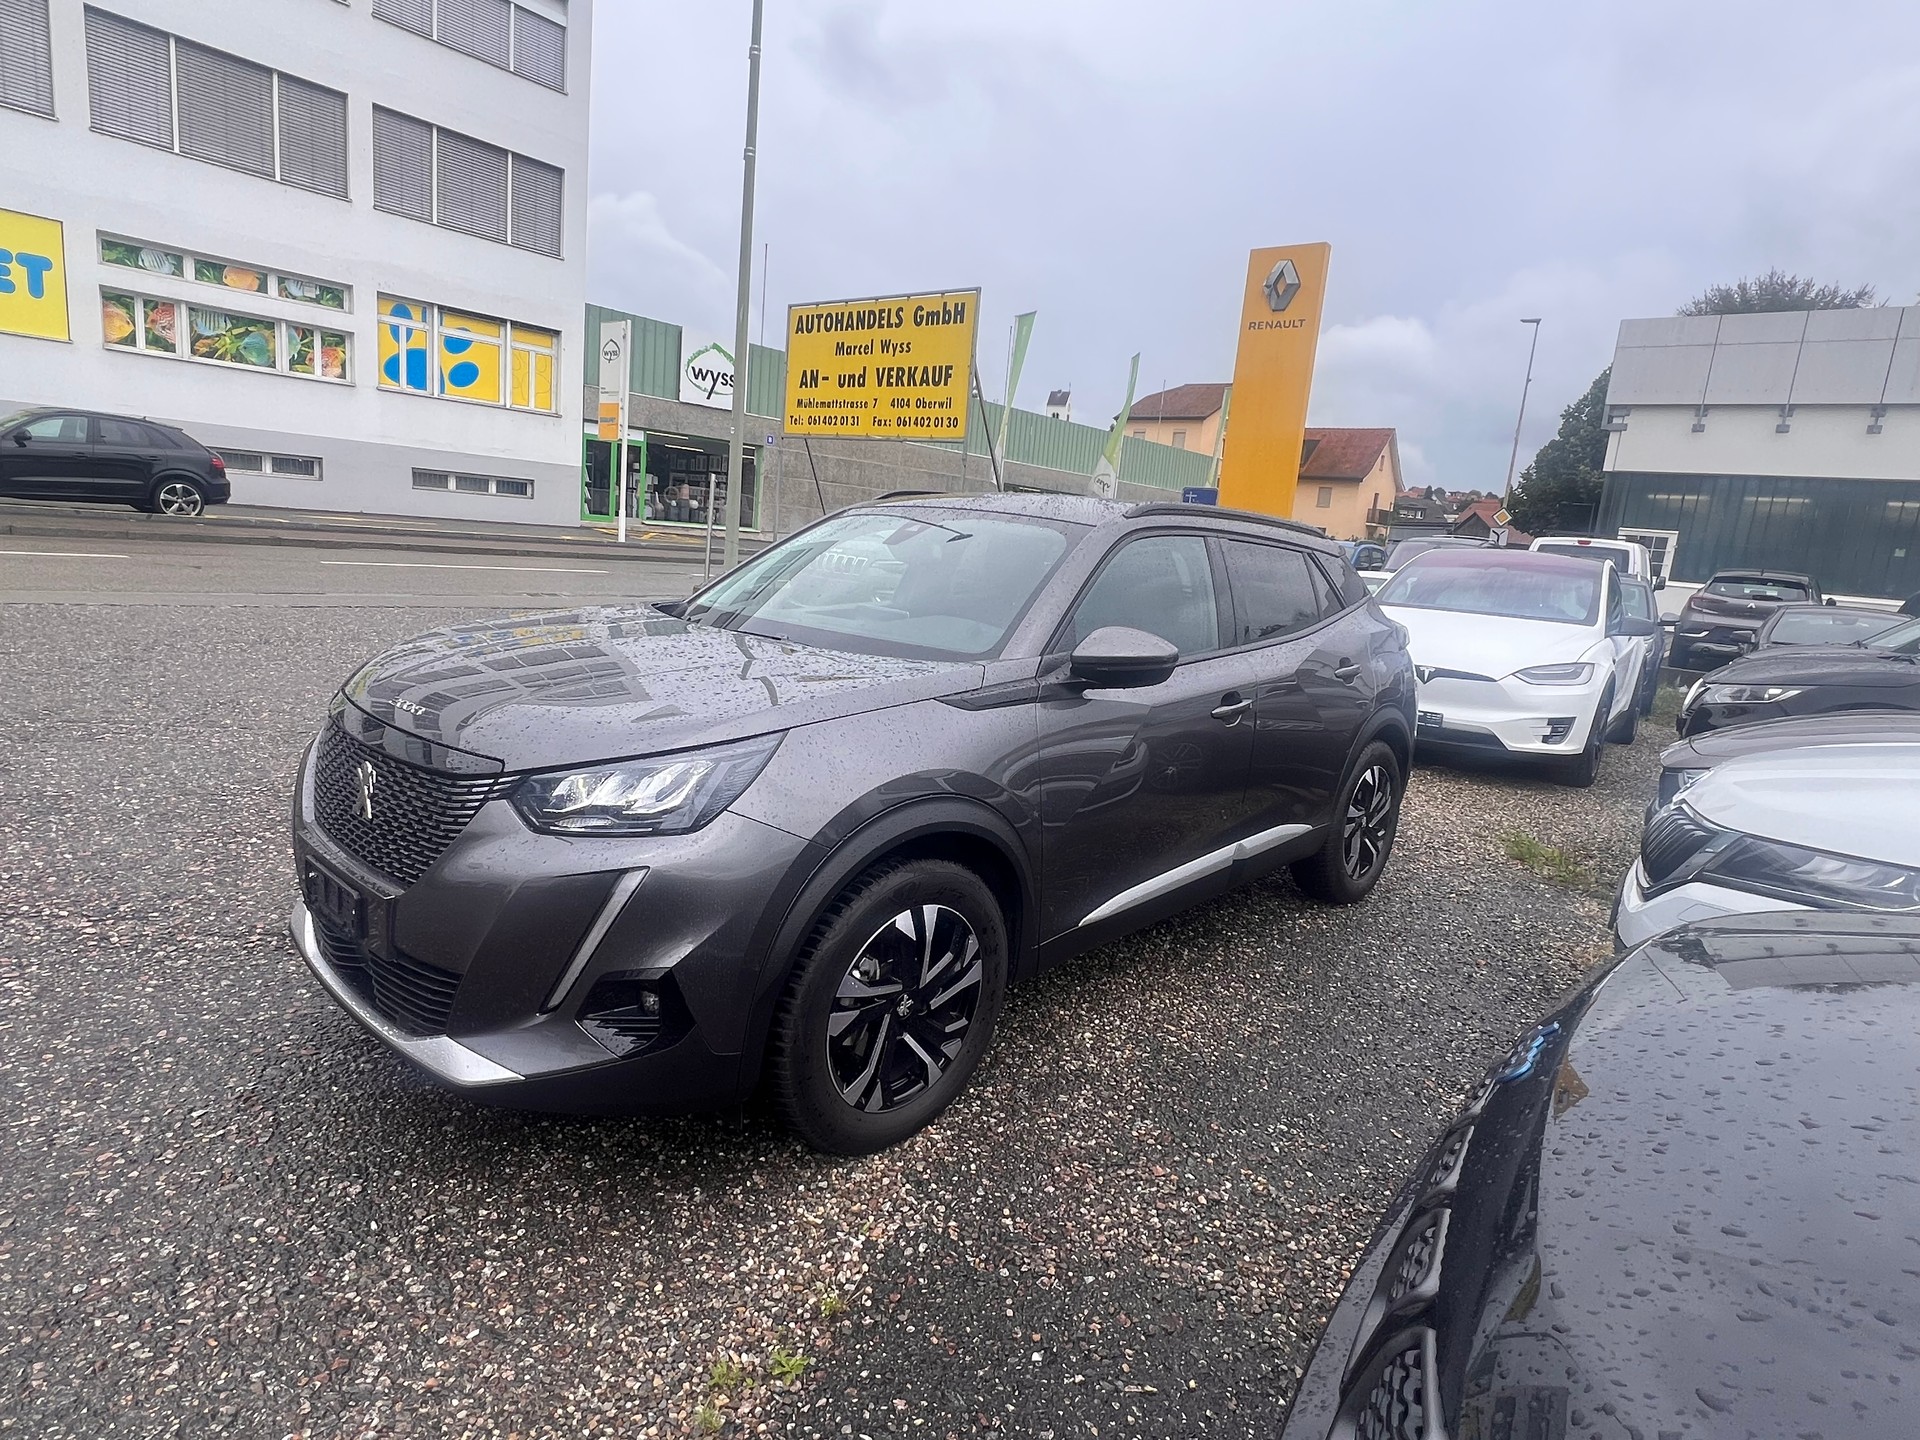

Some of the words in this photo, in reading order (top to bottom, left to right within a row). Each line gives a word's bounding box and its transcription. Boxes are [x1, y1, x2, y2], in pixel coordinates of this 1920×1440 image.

[795, 306, 904, 335] AUTOHANDELS
[913, 301, 966, 328] GmbH
[1248, 318, 1306, 331] RENAULT
[835, 339, 874, 356] Marcel
[880, 339, 911, 357] Wyss
[838, 366, 867, 388] und
[876, 365, 953, 388] VERKAUF
[796, 397, 869, 409] Mühlemattstrasse
[873, 398, 879, 409] 7
[890, 398, 911, 409] 4104
[915, 397, 952, 409] Oberwil
[790, 415, 804, 426] Tel:
[872, 416, 892, 427] Fax:
